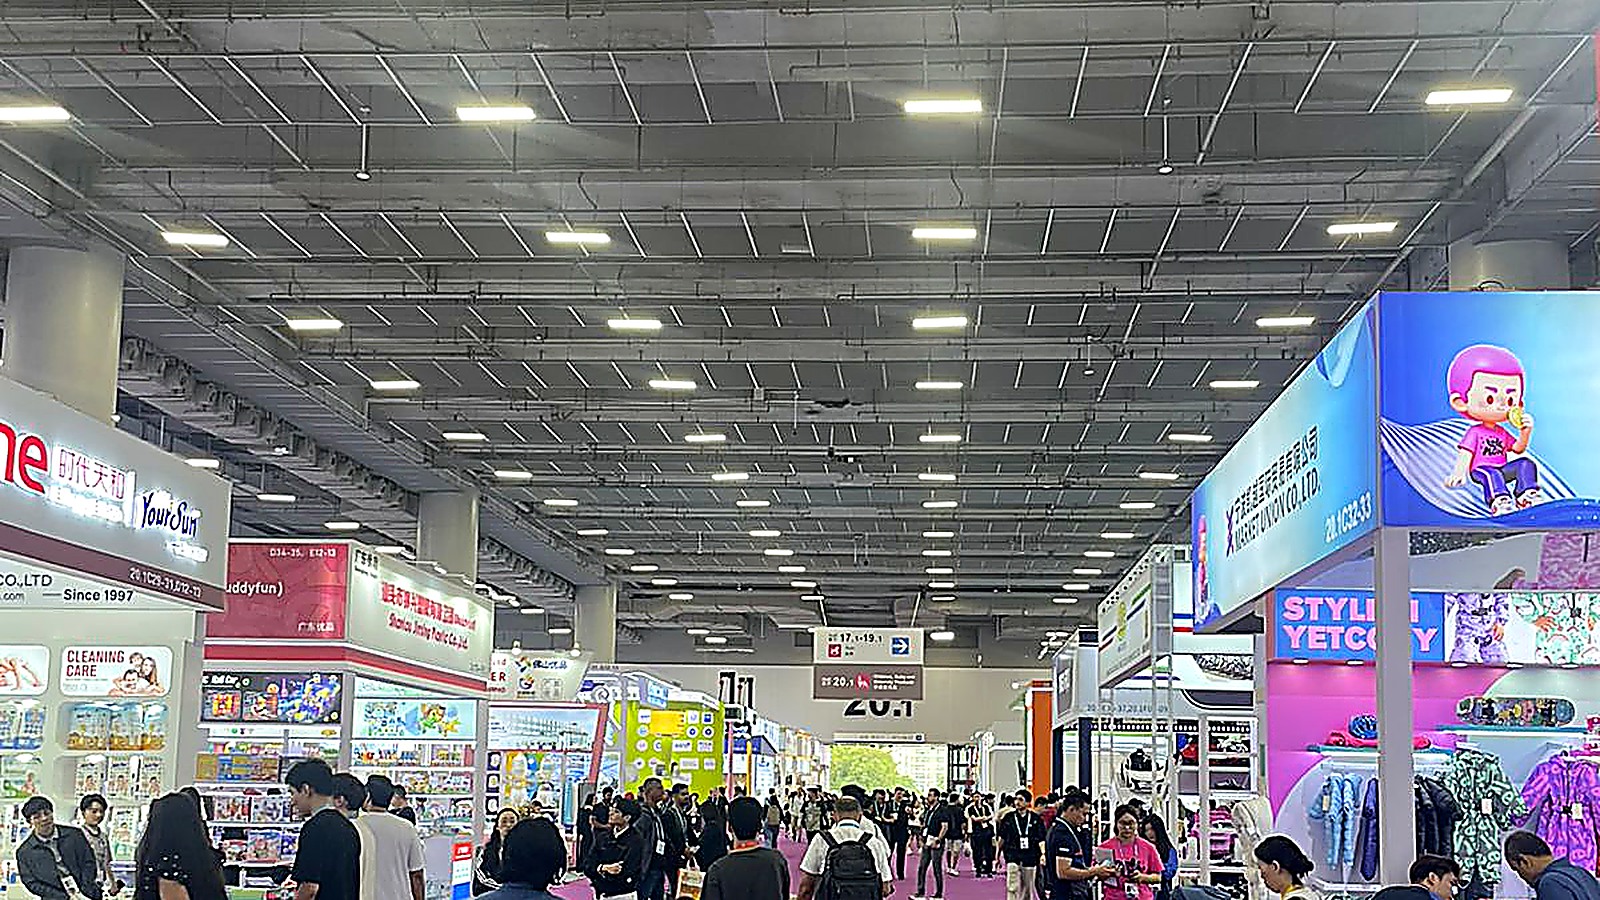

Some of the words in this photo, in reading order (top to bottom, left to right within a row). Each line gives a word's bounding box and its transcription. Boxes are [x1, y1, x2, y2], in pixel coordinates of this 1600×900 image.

[58, 448, 126, 499] 时代天和
[1261, 493, 1285, 533] UNION
[63, 588, 101, 601] Since
[104, 589, 134, 602] 1997
[67, 650, 125, 663] CLEANING
[66, 664, 97, 677] CARE
